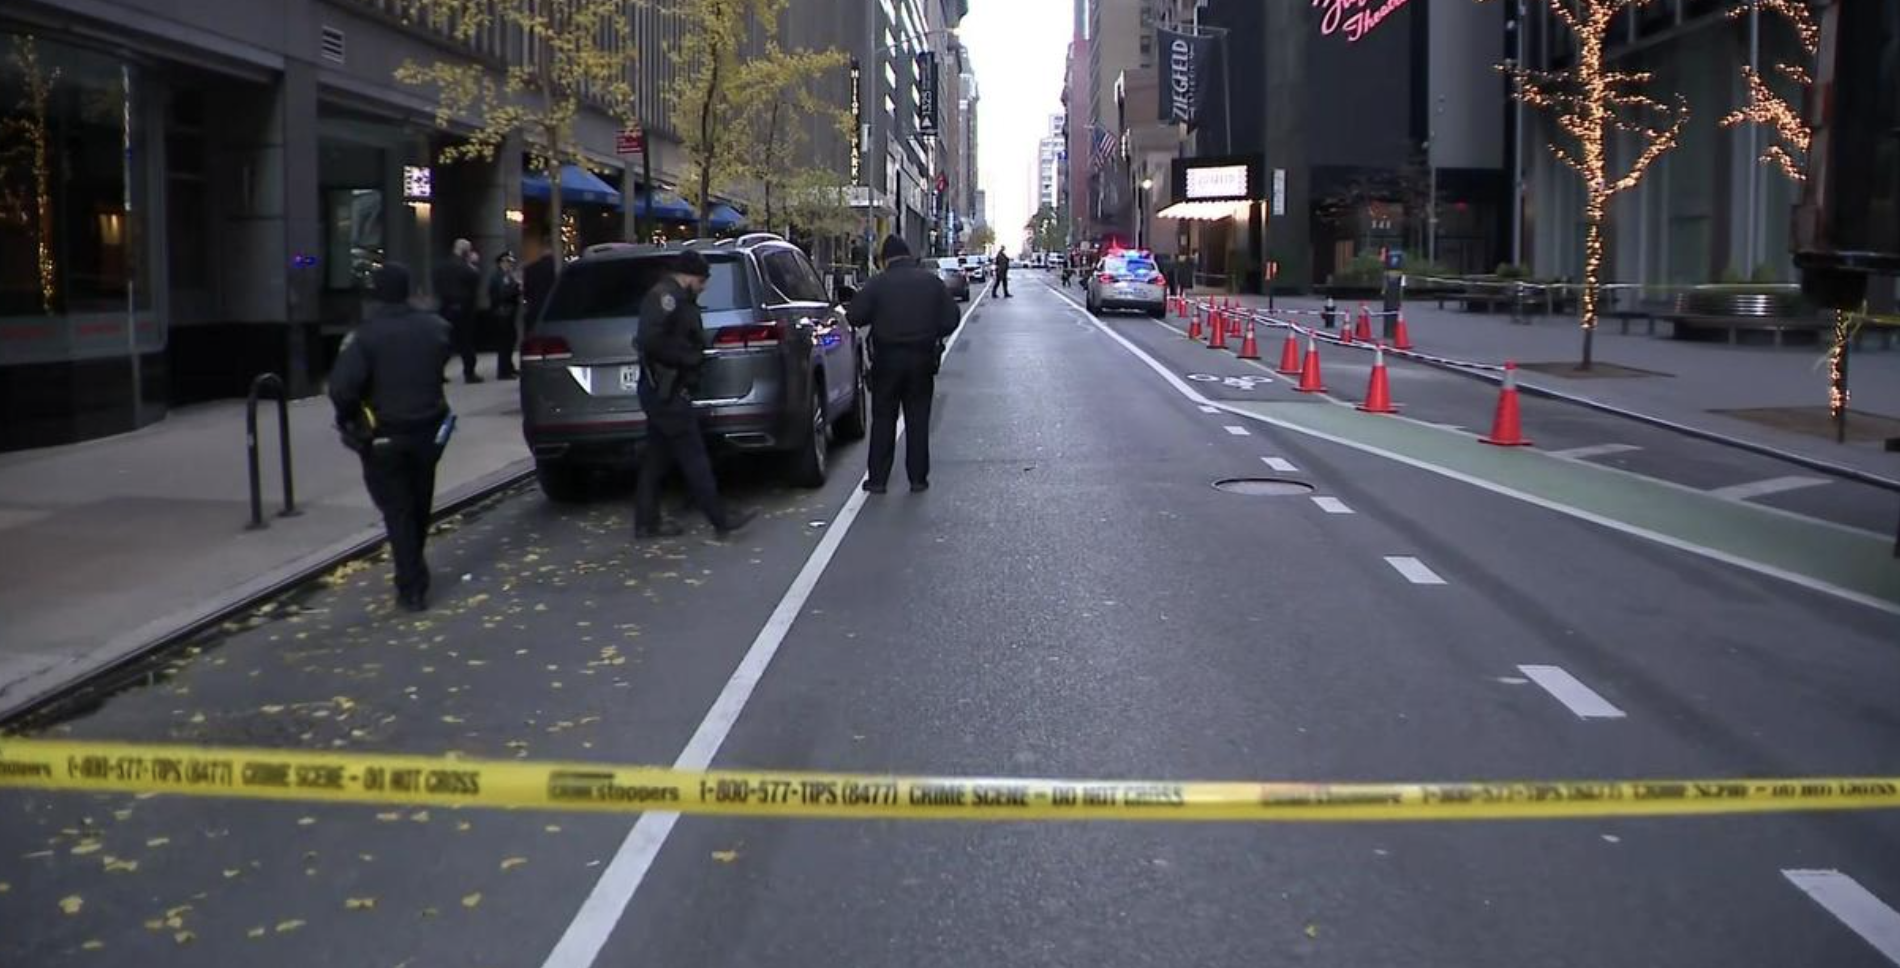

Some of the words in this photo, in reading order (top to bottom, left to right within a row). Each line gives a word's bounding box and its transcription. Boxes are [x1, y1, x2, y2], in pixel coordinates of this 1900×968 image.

[1170, 39, 1189, 121] ZIEGFELD
[700, 779, 838, 805] 1-800-577-TIPS
[842, 781, 898, 806] (8477)
[909, 783, 966, 807] CRIME
[971, 784, 1029, 807] SCENE
[1051, 785, 1077, 807] DO
[1082, 785, 1117, 807] NOT
